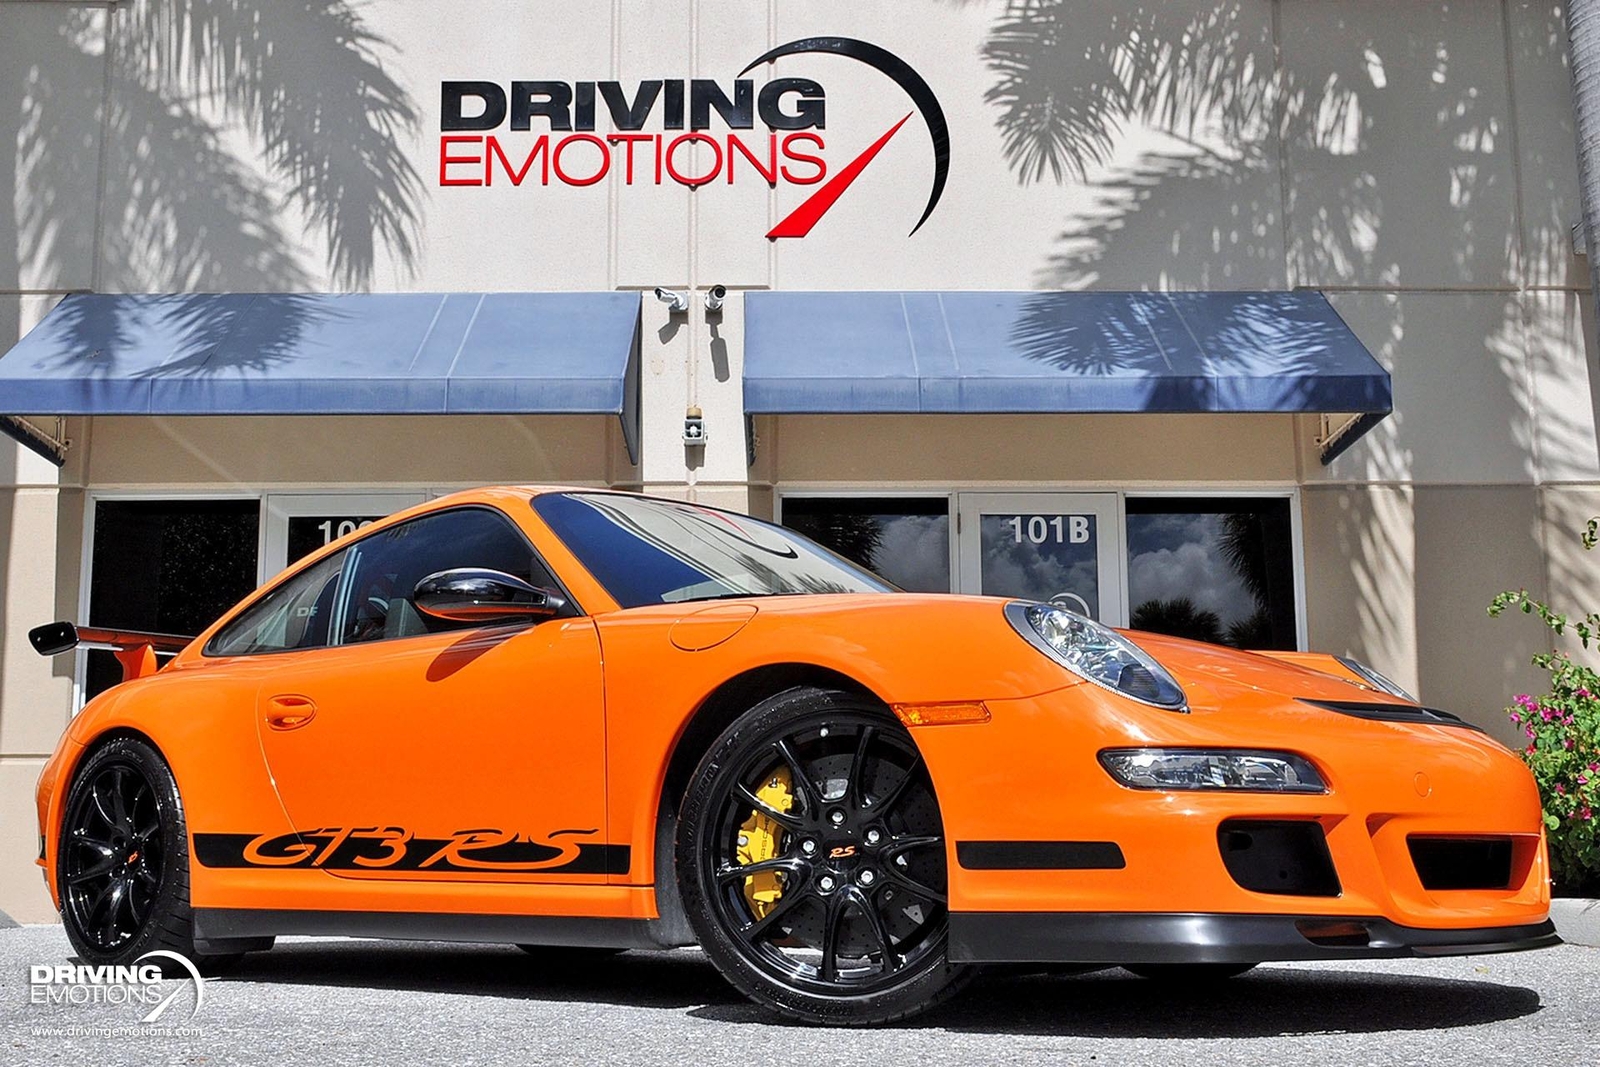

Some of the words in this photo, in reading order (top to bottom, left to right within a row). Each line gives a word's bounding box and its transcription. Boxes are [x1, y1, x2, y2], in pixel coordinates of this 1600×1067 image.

[440, 78, 826, 131] DRIVING
[439, 133, 827, 187] EMOTIONS
[318, 520, 374, 545] 10
[1009, 516, 1090, 543] 101B
[242, 826, 414, 867] GT3
[418, 828, 599, 870] RS
[829, 845, 856, 859] RS
